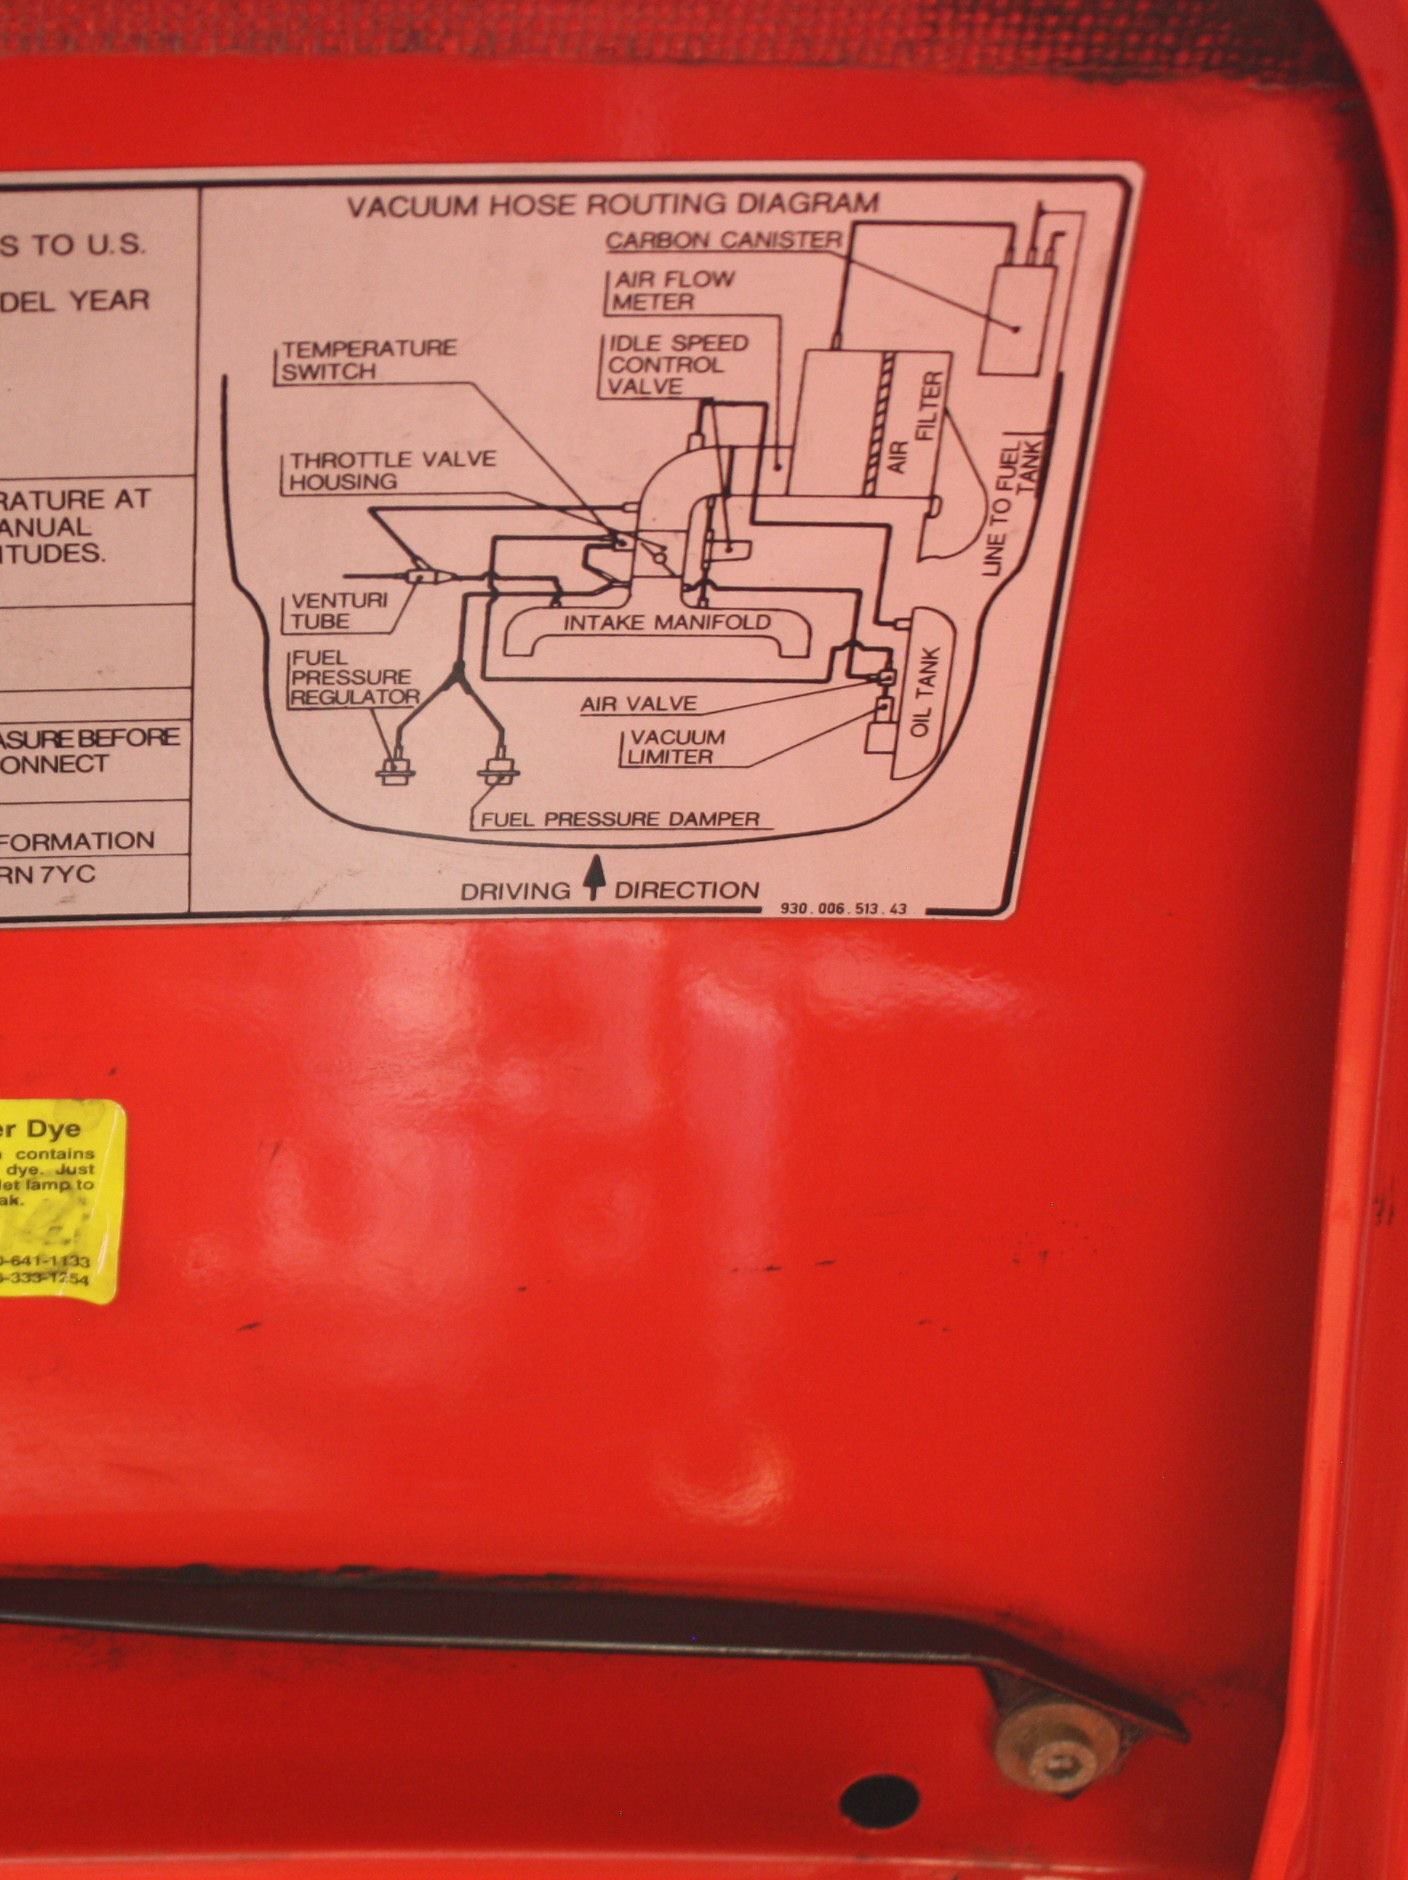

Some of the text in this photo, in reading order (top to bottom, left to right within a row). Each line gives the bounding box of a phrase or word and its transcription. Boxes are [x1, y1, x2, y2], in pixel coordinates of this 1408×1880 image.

[346, 191, 880, 219] VACUUM HOSE ROUTING DIAGRAM
[31, 233, 75, 257] TO
[606, 231, 842, 250] CARBON CANISTER
[614, 269, 736, 289] AIR FLOW
[69, 288, 150, 312] YEAR
[612, 292, 696, 312] METER
[282, 338, 458, 360] TEMPERATURE
[609, 333, 750, 353] IDLE SPEED
[281, 362, 376, 382] SWITCH
[607, 355, 725, 375] CONTROL
[607, 377, 684, 396] VALVE
[915, 370, 944, 441] FILTER
[289, 449, 497, 470] THROTTLE VALVE
[888, 440, 909, 474] AIR
[1015, 440, 1042, 496] TANK
[289, 472, 398, 492] HOUSING
[114, 487, 152, 510] AT
[981, 440, 1021, 576] LINE TO FUEL
[291, 591, 388, 610] VENTURI
[290, 612, 351, 631] TUBE
[563, 613, 772, 631] INTAKE MANIFOLD
[292, 649, 349, 667] FUEL
[291, 668, 412, 686] PRESSURE
[290, 688, 421, 706] REGULATOR
[910, 646, 941, 738] OIL TANK
[579, 695, 698, 713] AIR VALVE
[630, 728, 726, 746] VACUUM
[627, 748, 714, 765] LIMITER
[480, 811, 761, 828] FUEL PRESSURE DAMPER
[460, 881, 571, 902] DRIVING
[614, 880, 760, 900] DIRECTION
[26, 1118, 82, 1144] Dye
[15, 1147, 96, 1161] contains
[6, 1164, 45, 1179] dye.
[56, 1163, 95, 1176] Just
[26, 1179, 71, 1193] lamp
[75, 1178, 95, 1191] to
